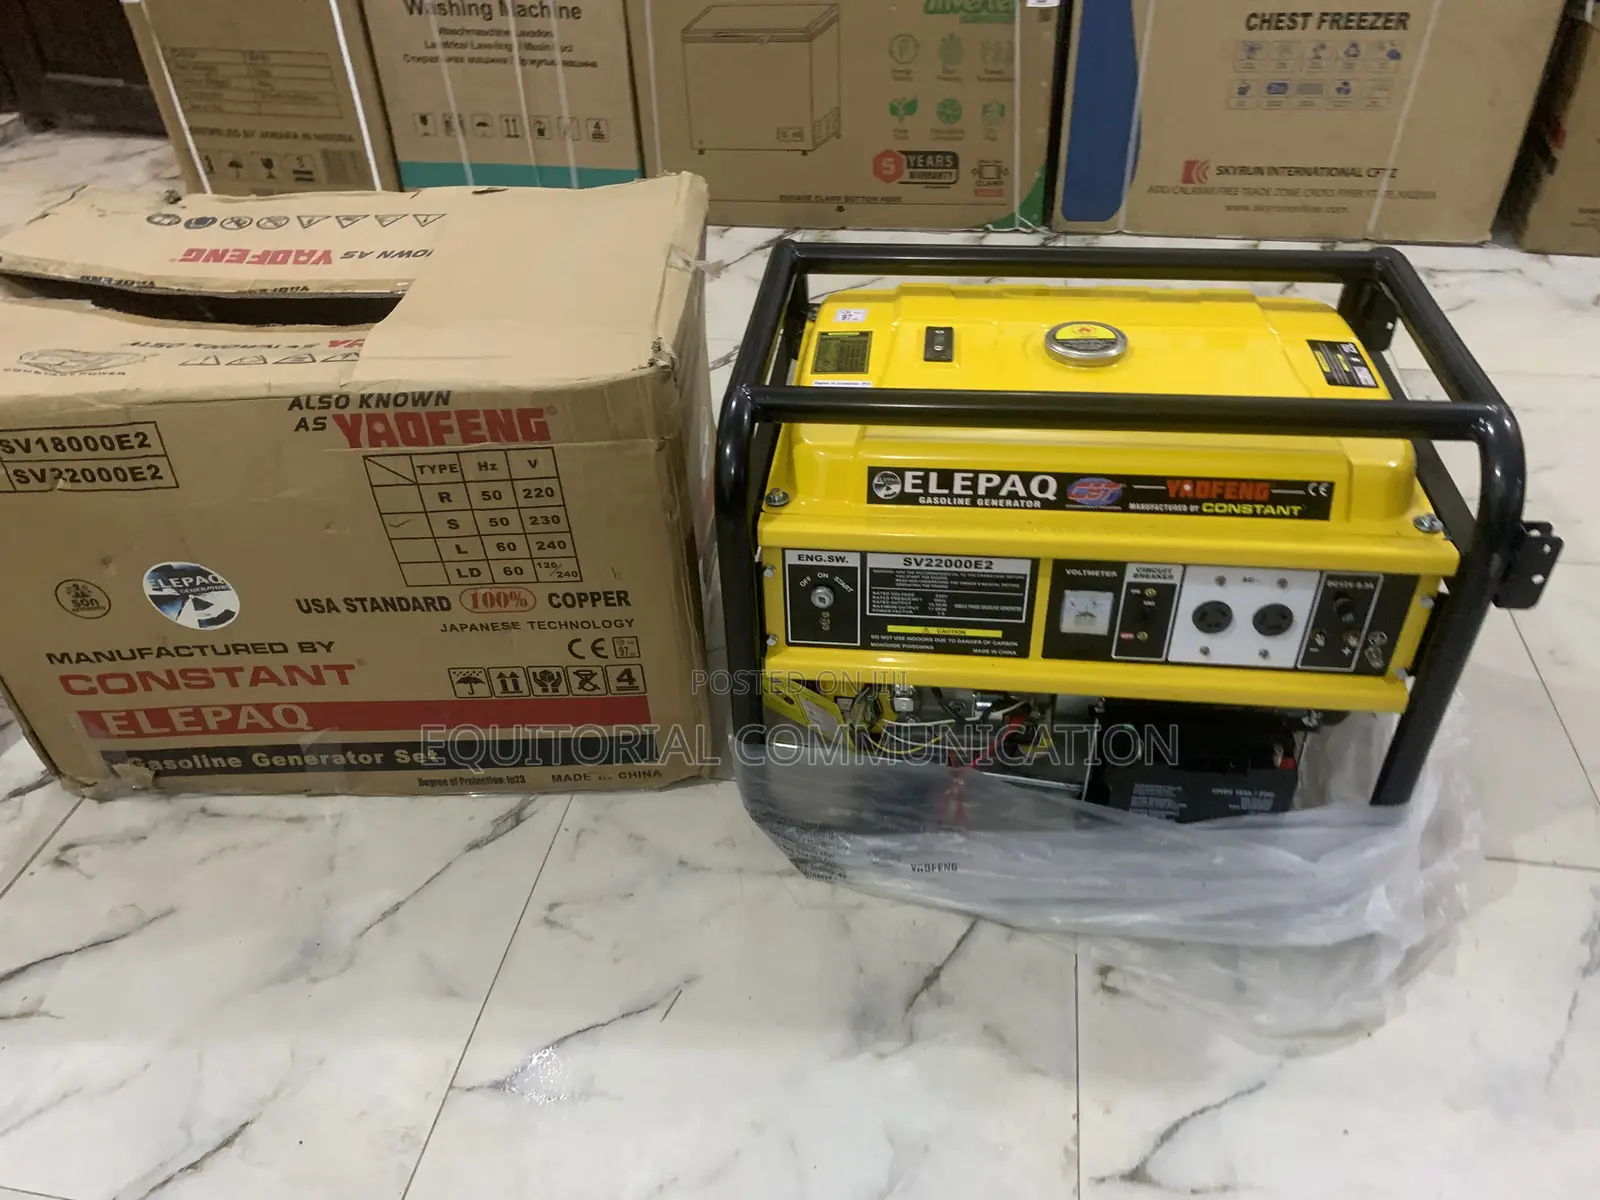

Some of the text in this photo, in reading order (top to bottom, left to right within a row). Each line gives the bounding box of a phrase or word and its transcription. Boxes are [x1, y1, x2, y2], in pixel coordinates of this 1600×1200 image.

[500, 0, 582, 19] Machne
[1245, 11, 1411, 31] CHEST FREEZER
[881, 154, 955, 176] 5 YEARS
[1366, 167, 1398, 179] CFZ
[178, 247, 333, 265] YAOFENG
[288, 390, 453, 412] ALSO KNOWN
[294, 406, 551, 449] AS YAOFENG
[0, 432, 151, 455] SV18000E2
[13, 463, 164, 486] SV22000E2
[416, 458, 538, 476] TYPE Hz V
[904, 470, 1057, 500] ELEPAQ
[1166, 479, 1269, 501] YAOFENG
[438, 486, 556, 505] R 50 220
[919, 496, 1041, 509] GASOLINE GENERATOR
[1128, 502, 1187, 513] MANUFACTURED
[1201, 502, 1303, 517] CONSTANT
[446, 513, 562, 532] S 50 230
[455, 539, 567, 556] L 60 240
[797, 553, 849, 564] ENG.SW.
[902, 557, 994, 570] SV22000E2
[457, 567, 482, 580] LD
[503, 565, 525, 578] 60
[817, 571, 829, 579] ON
[1066, 568, 1118, 578] VOLTMETER
[1135, 566, 1173, 574] CIRCUIT
[149, 573, 226, 593] ELEPAQ
[799, 576, 812, 587] OFF
[834, 576, 854, 594] START
[296, 590, 632, 614] USA STANDARD 100% COPPER
[440, 617, 635, 633] JAPANESE TECHNOLOGY
[46, 641, 335, 665] MANUFACTURED BY
[618, 646, 629, 657] 97
[58, 663, 357, 697] CONSTANT
[101, 703, 313, 738] ELEPAQ
[251, 751, 385, 770] Generator
[396, 748, 440, 765] Set
[551, 773, 593, 784] MADE
[618, 769, 664, 781] CHINA
